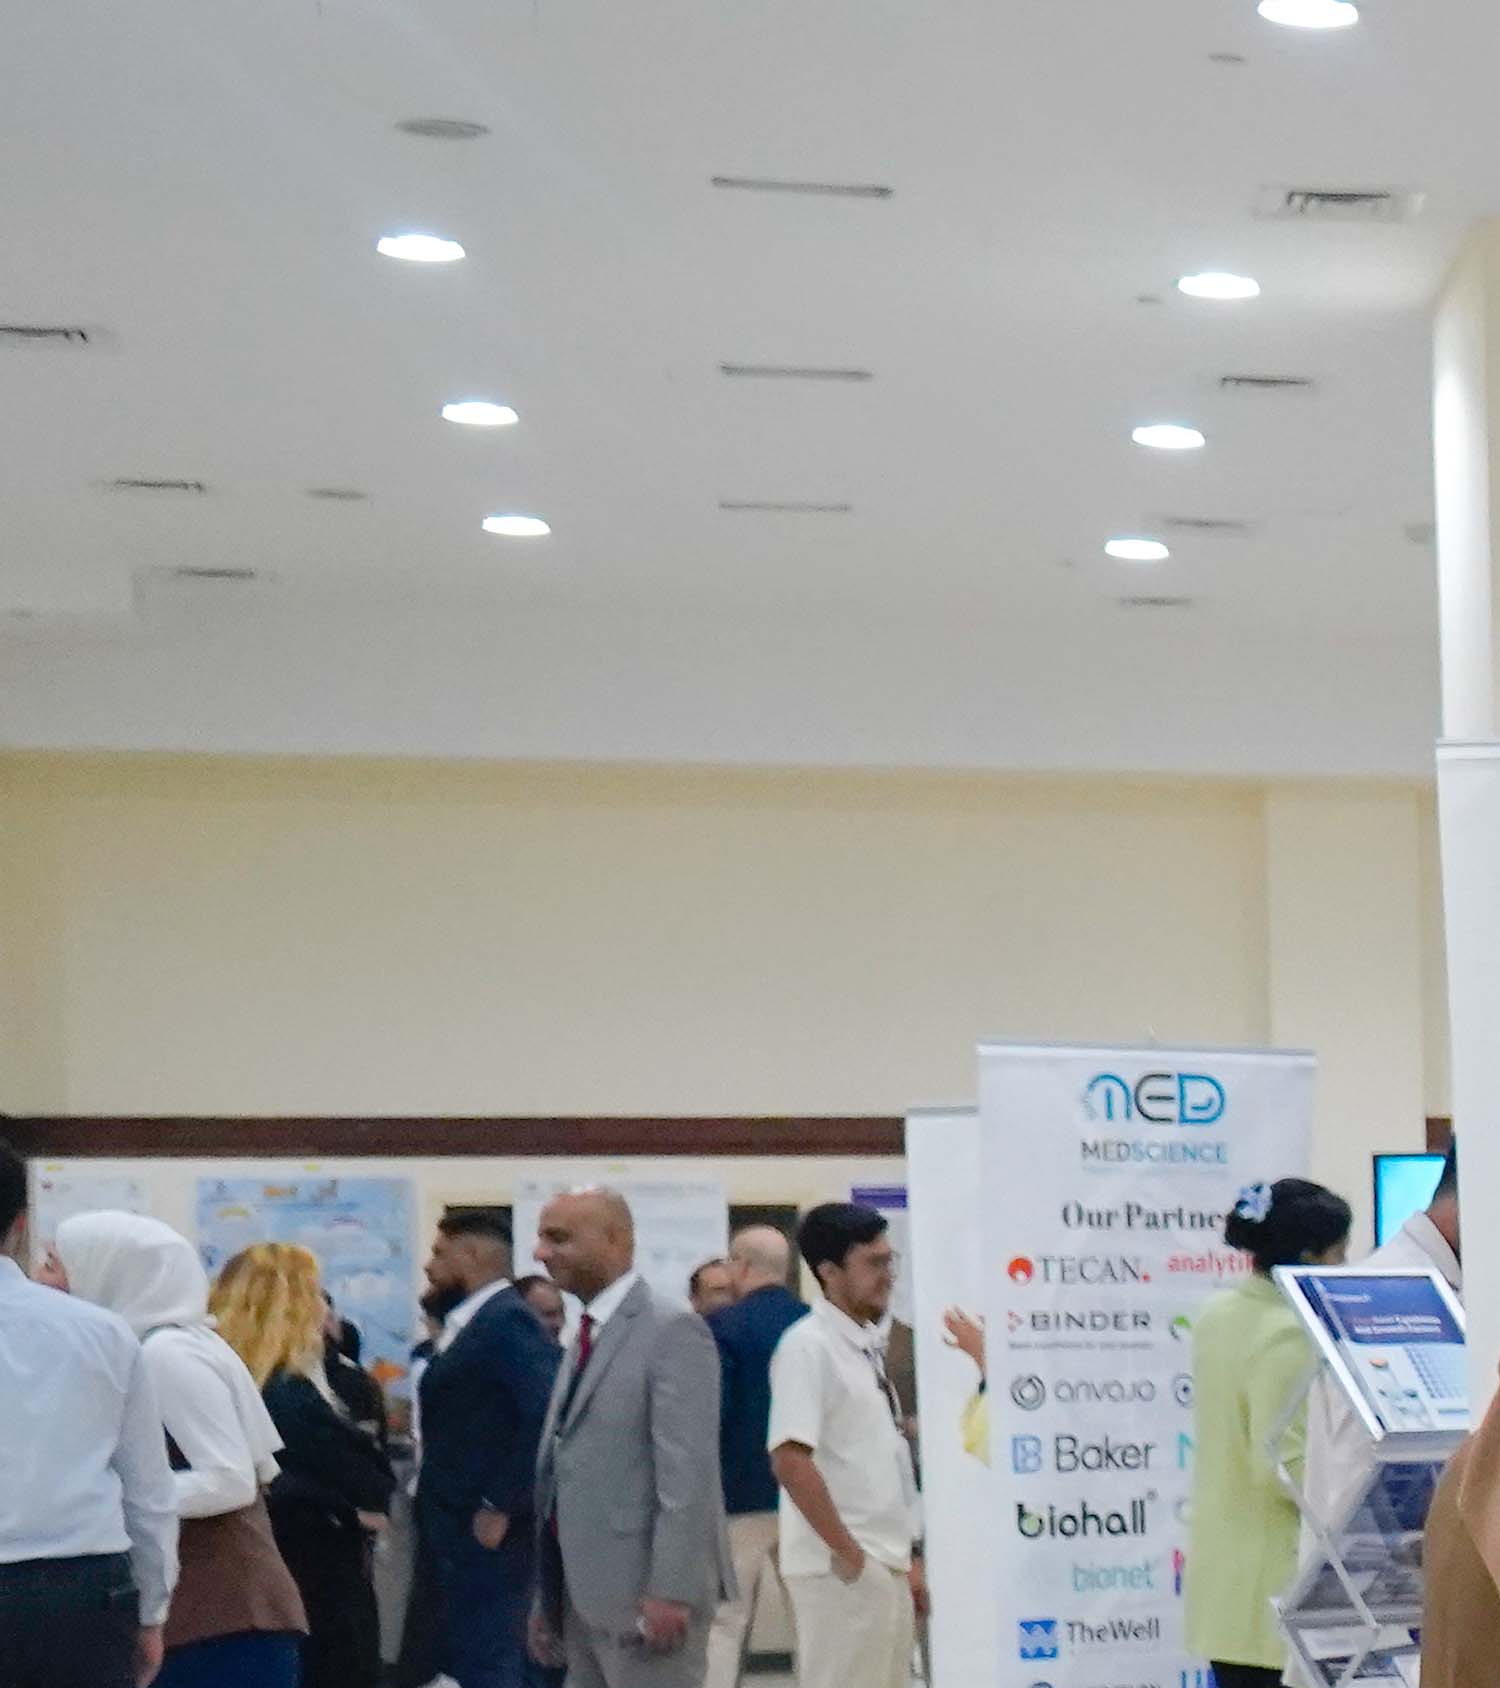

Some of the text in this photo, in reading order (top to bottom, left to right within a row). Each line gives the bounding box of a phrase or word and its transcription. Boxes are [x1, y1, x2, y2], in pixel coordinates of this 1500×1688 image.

[1081, 1140, 1228, 1164] MEDSCIENCE
[1062, 1201, 1226, 1232] Our Partne
[1031, 1310, 1151, 1331] BINDER
[1055, 1433, 1156, 1473] Baker
[1016, 1499, 1147, 1538] biohall
